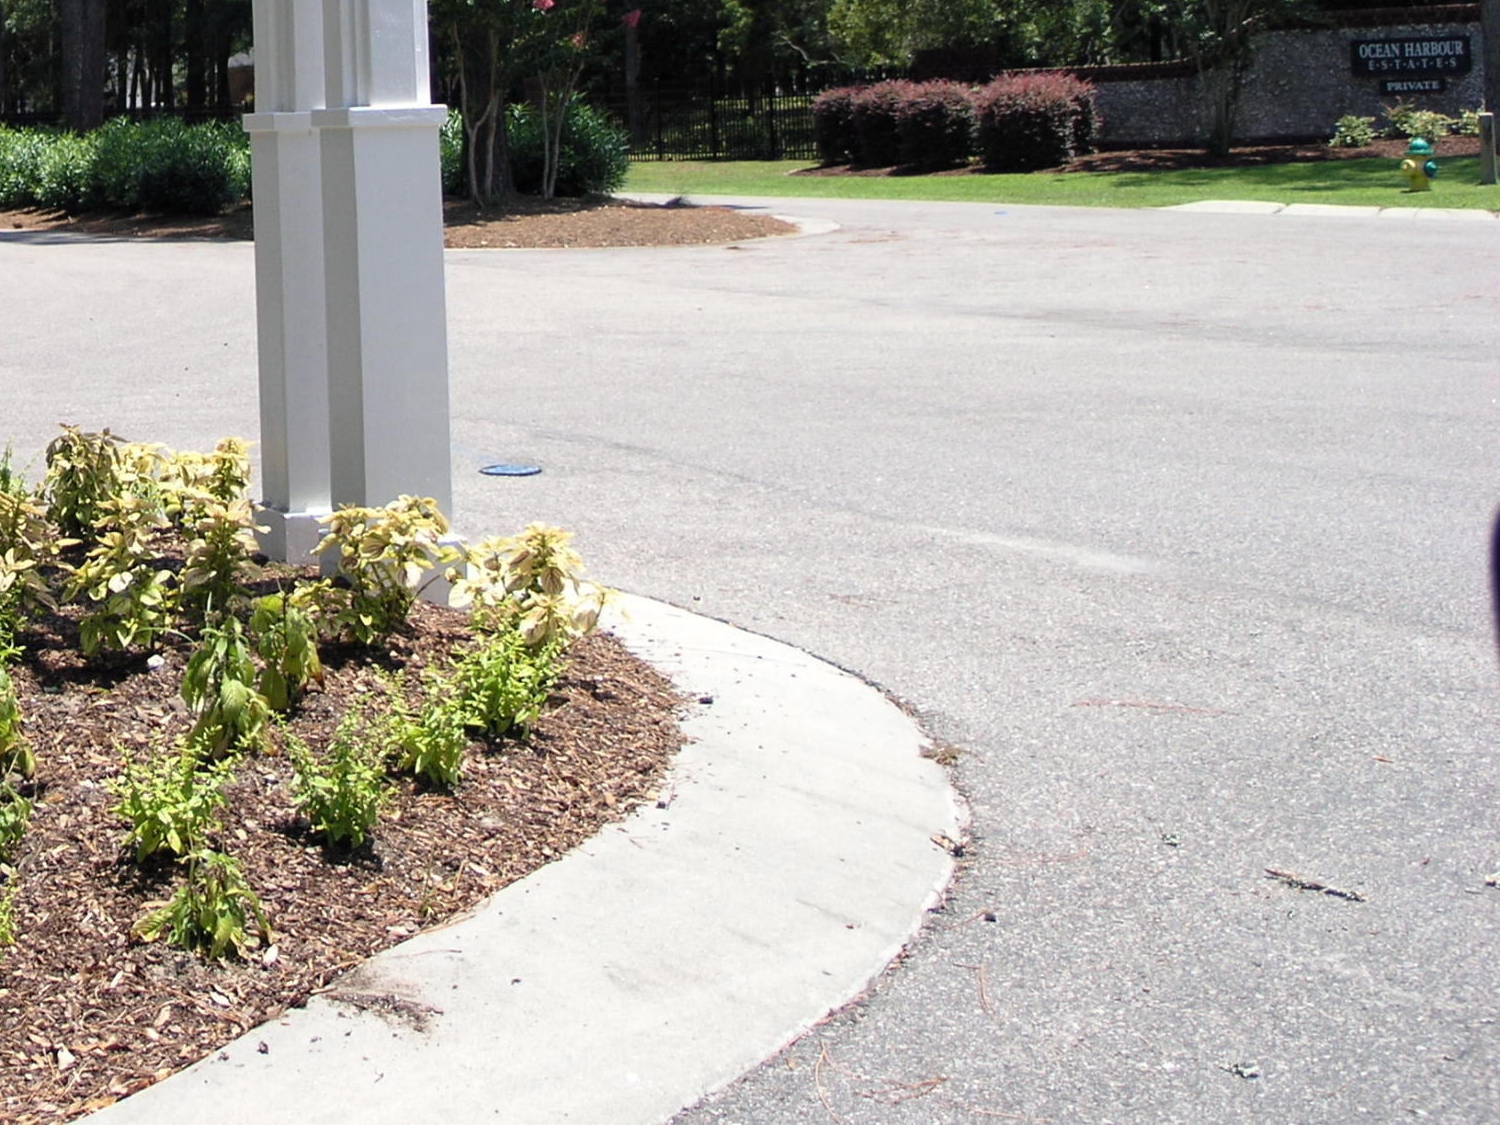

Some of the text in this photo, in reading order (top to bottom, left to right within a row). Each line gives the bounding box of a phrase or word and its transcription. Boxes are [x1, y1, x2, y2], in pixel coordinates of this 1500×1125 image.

[1359, 41, 1464, 58] OCEAN HARBOUR
[1387, 80, 1441, 91] PRIVATE
